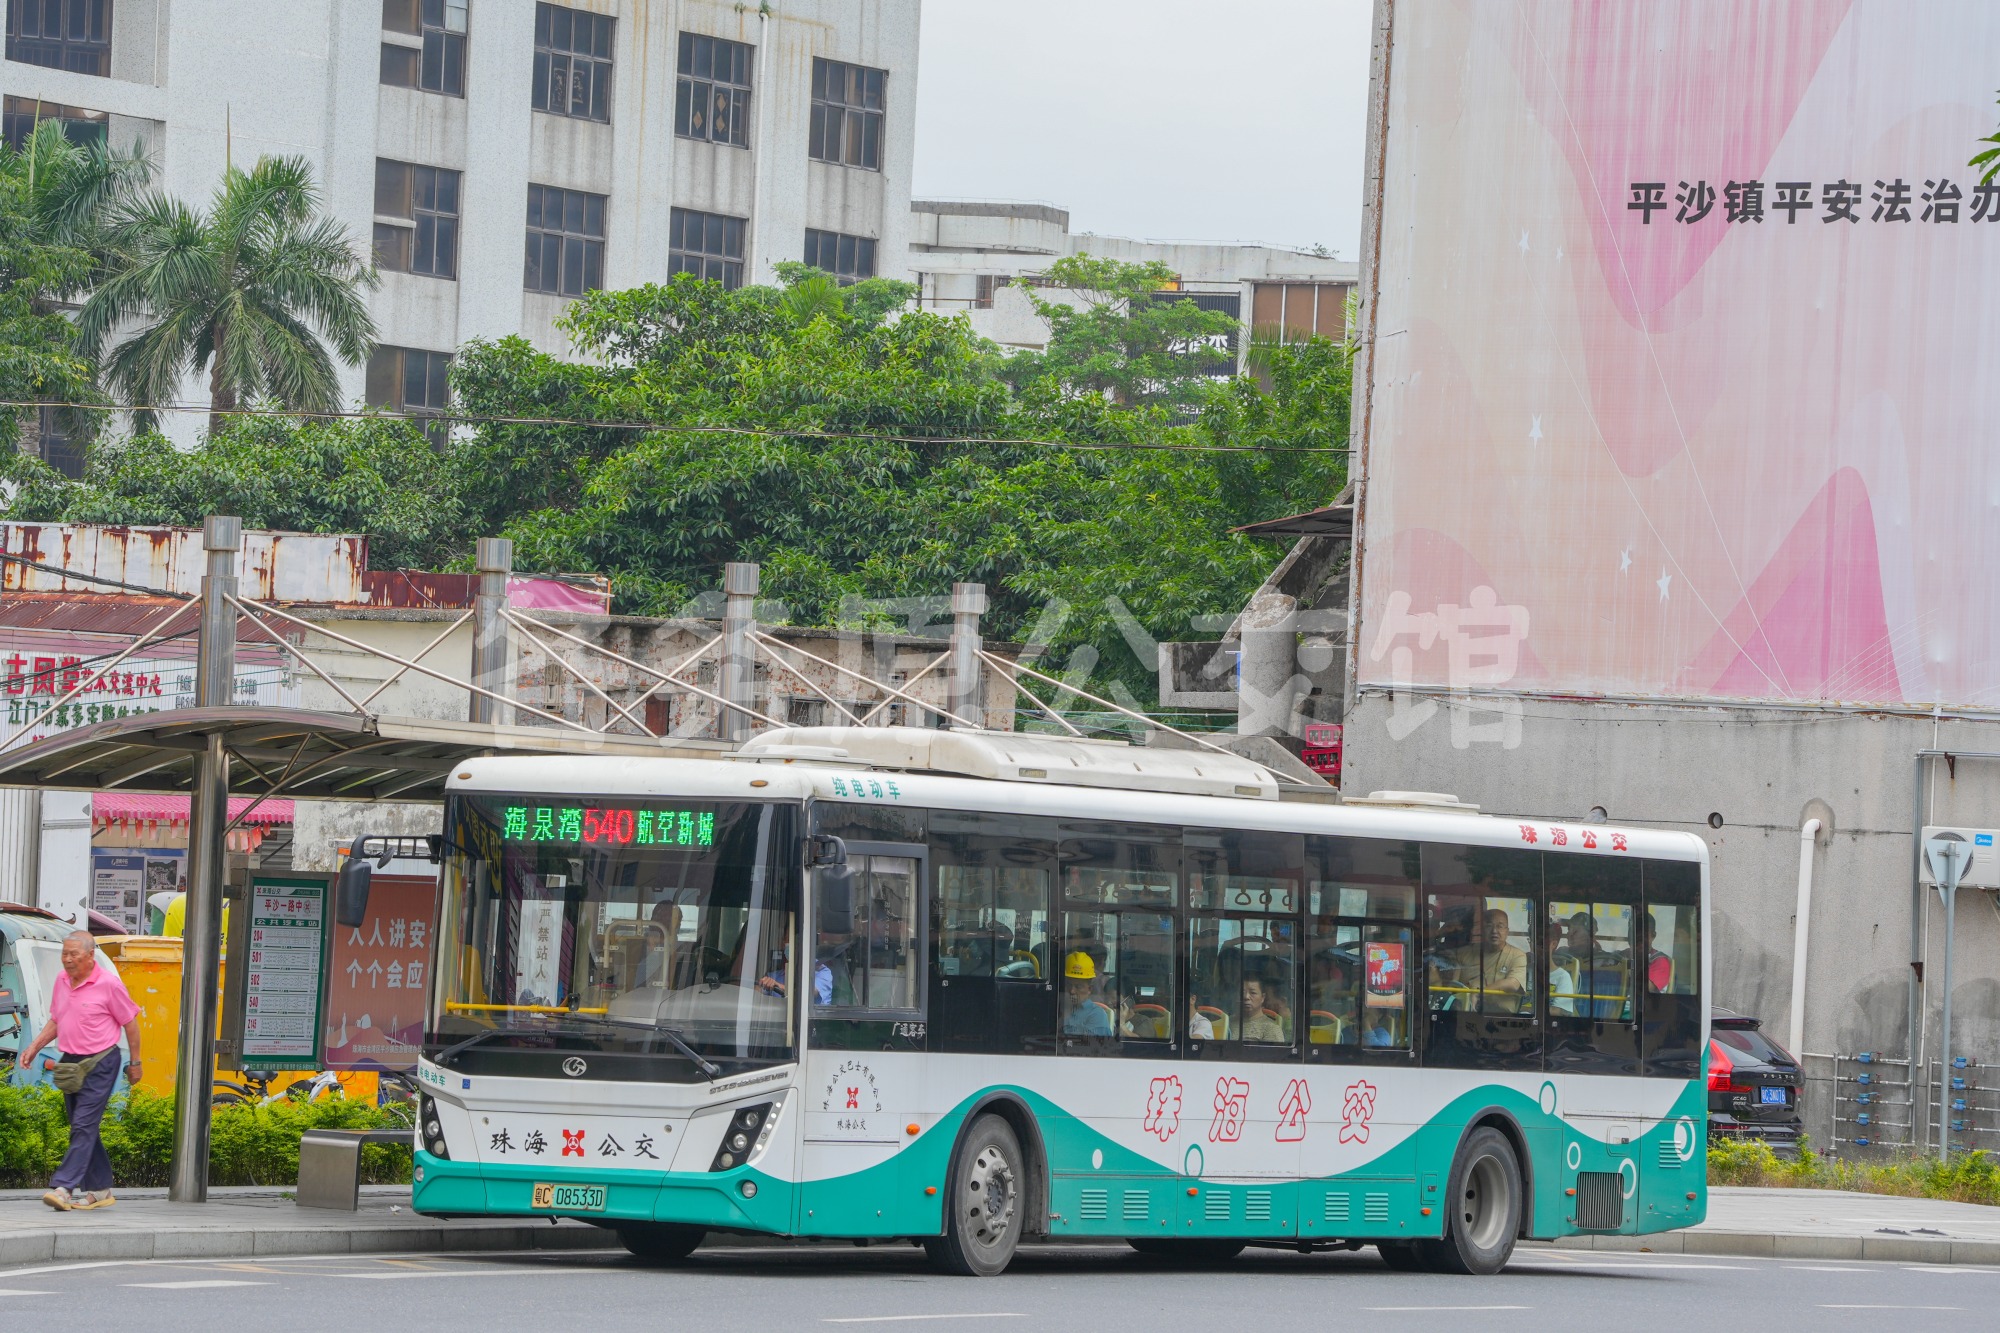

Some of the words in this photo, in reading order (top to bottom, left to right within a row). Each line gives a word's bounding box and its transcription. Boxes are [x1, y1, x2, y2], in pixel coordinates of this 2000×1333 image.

[1627, 178, 2000, 225] 平沙镇平安法治办
[832, 776, 900, 800] 纯电动车
[504, 807, 582, 842] 海泉湾
[583, 808, 635, 843] 540
[637, 810, 714, 846] 航空新城
[1518, 824, 1627, 851] 珠海公交
[265, 899, 303, 913] 平沙一路中
[256, 918, 318, 927] 公共汽车站
[347, 917, 433, 949] 人人讲安
[252, 951, 262, 963] 501
[250, 974, 260, 985] 502
[249, 996, 259, 1008] 540
[892, 1021, 926, 1037] 广通客车
[1143, 1074, 1377, 1144] 珠海公交
[837, 1118, 867, 1131] 珠海公交
